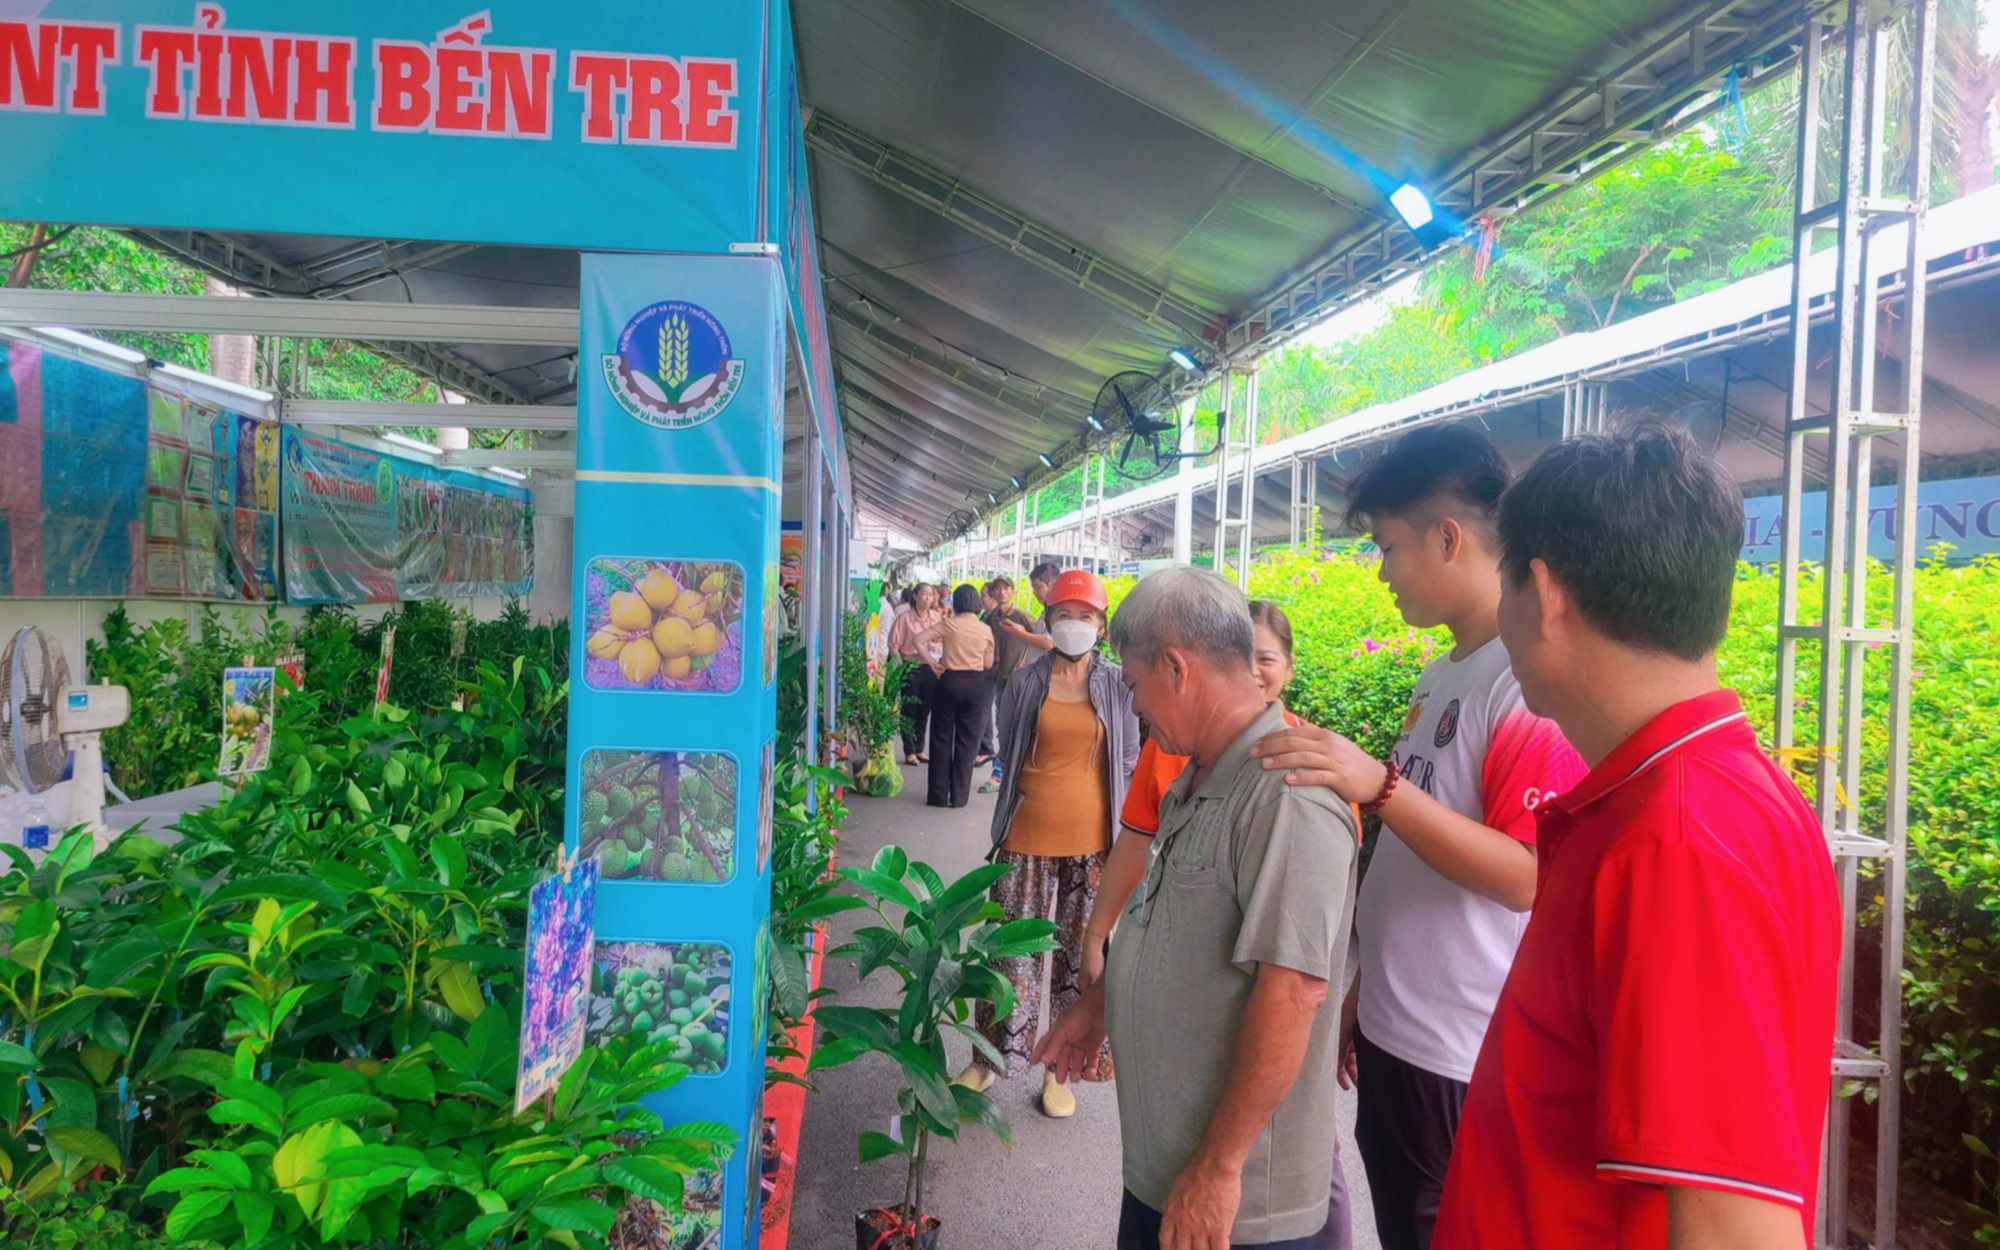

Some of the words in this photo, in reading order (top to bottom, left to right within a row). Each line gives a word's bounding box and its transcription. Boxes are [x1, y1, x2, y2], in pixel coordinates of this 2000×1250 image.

[0, 19, 118, 112] NT
[138, 6, 355, 126] TỈNH
[374, 13, 553, 136] BẾN
[572, 54, 738, 146] TRE
[605, 359, 613, 369] SỞ
[733, 364, 742, 377] TRE
[606, 369, 621, 393] NÔNG
[727, 378, 739, 393] BẾN
[617, 392, 641, 414] NGHIỆP
[713, 390, 732, 410] THÔN
[640, 410, 651, 422] VÀ
[652, 416, 671, 427] PHÁT
[672, 413, 693, 427] TRIỂN
[692, 406, 716, 423] NÔNG
[1744, 514, 1783, 554] ỊA
